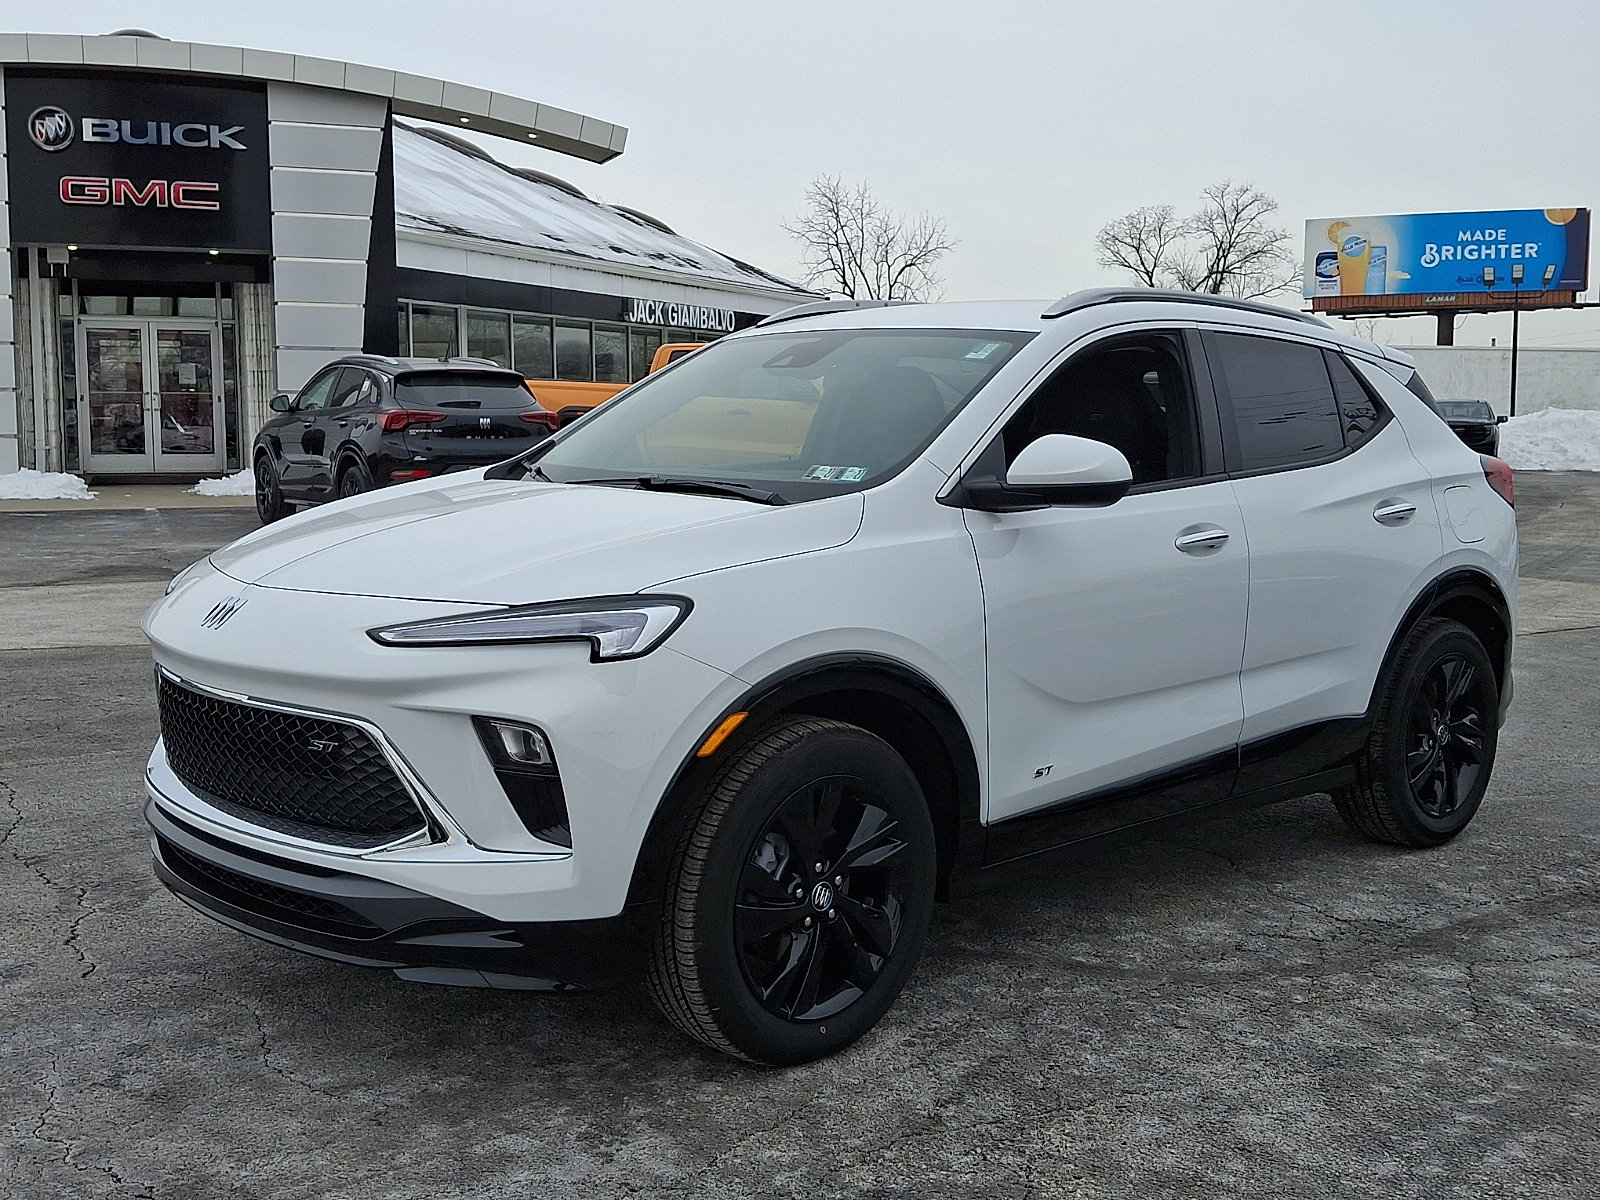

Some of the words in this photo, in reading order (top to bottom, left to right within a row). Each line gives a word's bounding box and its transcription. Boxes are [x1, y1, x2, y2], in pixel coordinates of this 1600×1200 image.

[82, 117, 248, 150] BUICK
[59, 175, 220, 211] GMC
[1457, 229, 1507, 242] MADE
[1420, 242, 1539, 268] BRIGHTER
[1425, 295, 1457, 303] LAMAR
[629, 298, 665, 325] JACK
[668, 302, 736, 332] GIAMBALVO
[308, 739, 339, 753] ST
[1032, 764, 1054, 780] ST
